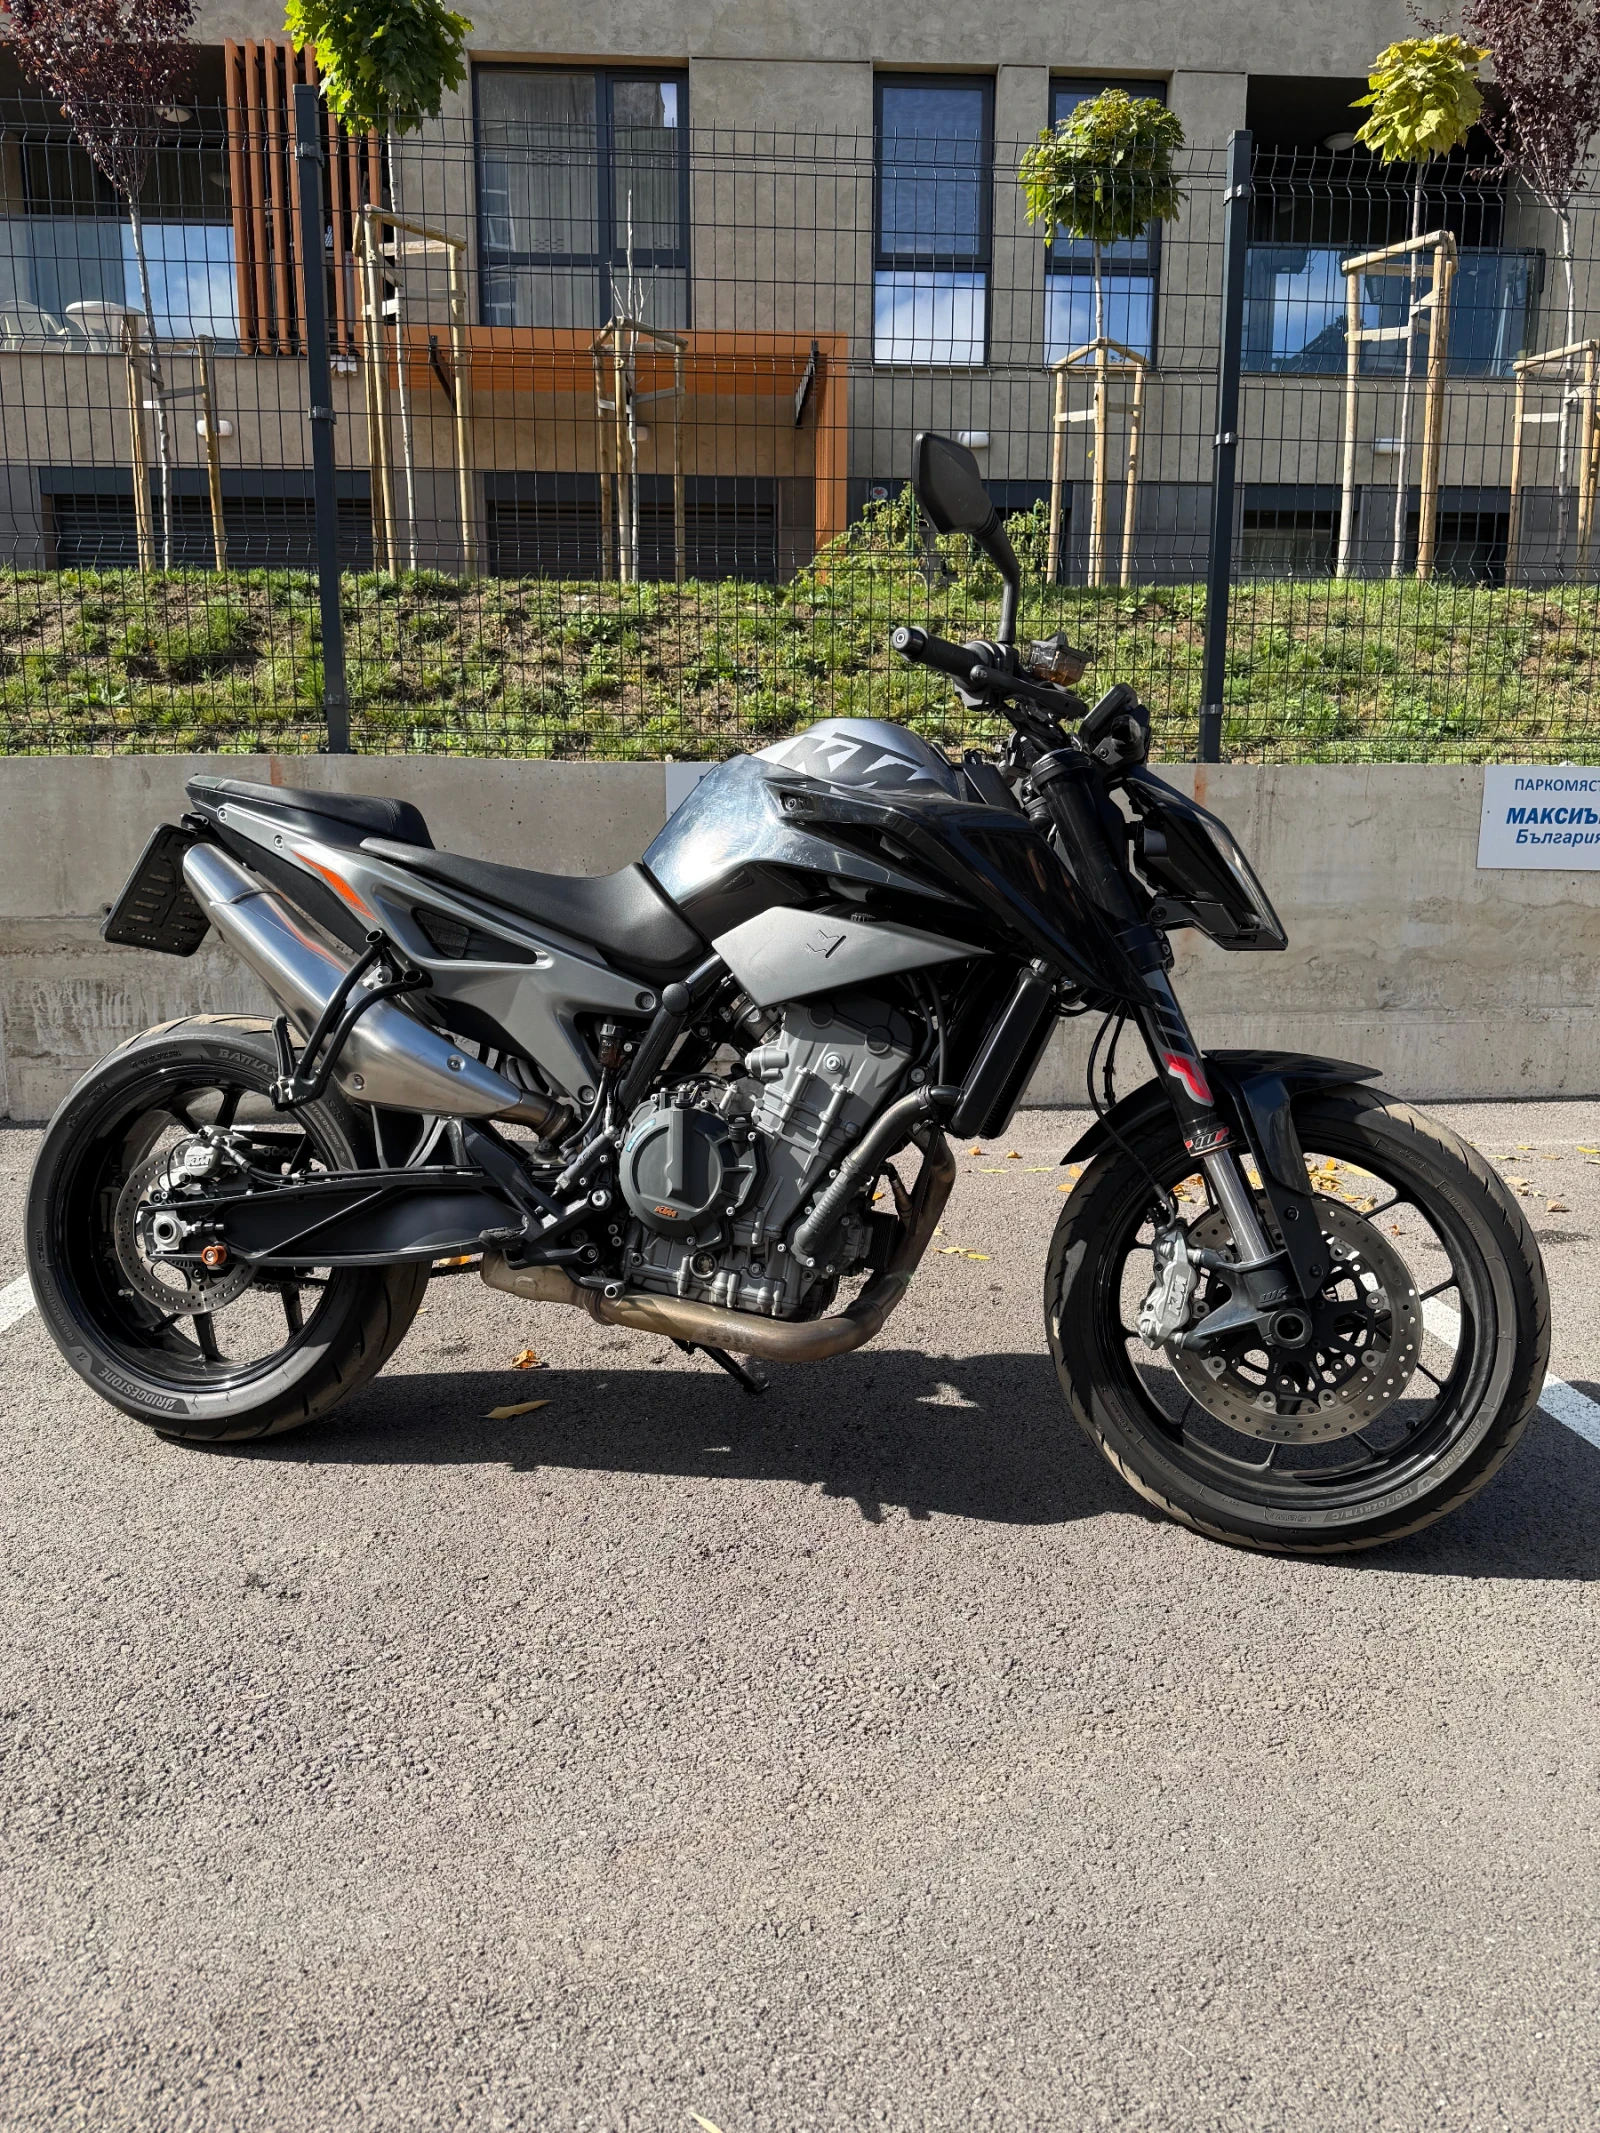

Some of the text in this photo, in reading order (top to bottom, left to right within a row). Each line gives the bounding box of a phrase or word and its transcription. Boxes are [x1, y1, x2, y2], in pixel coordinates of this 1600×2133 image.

[1506, 807, 1600, 825] МАКСИЪ
[217, 1048, 279, 1079] BATTLAX
[187, 1153, 212, 1167] KTM
[654, 1205, 678, 1218] KTM
[1167, 1274, 1189, 1317] KTM
[98, 1366, 178, 1411] BRIDGESTONE
[1437, 1417, 1485, 1474] BRIDGESTONE
[1331, 1487, 1414, 1521] 120/70ZR17M/C
